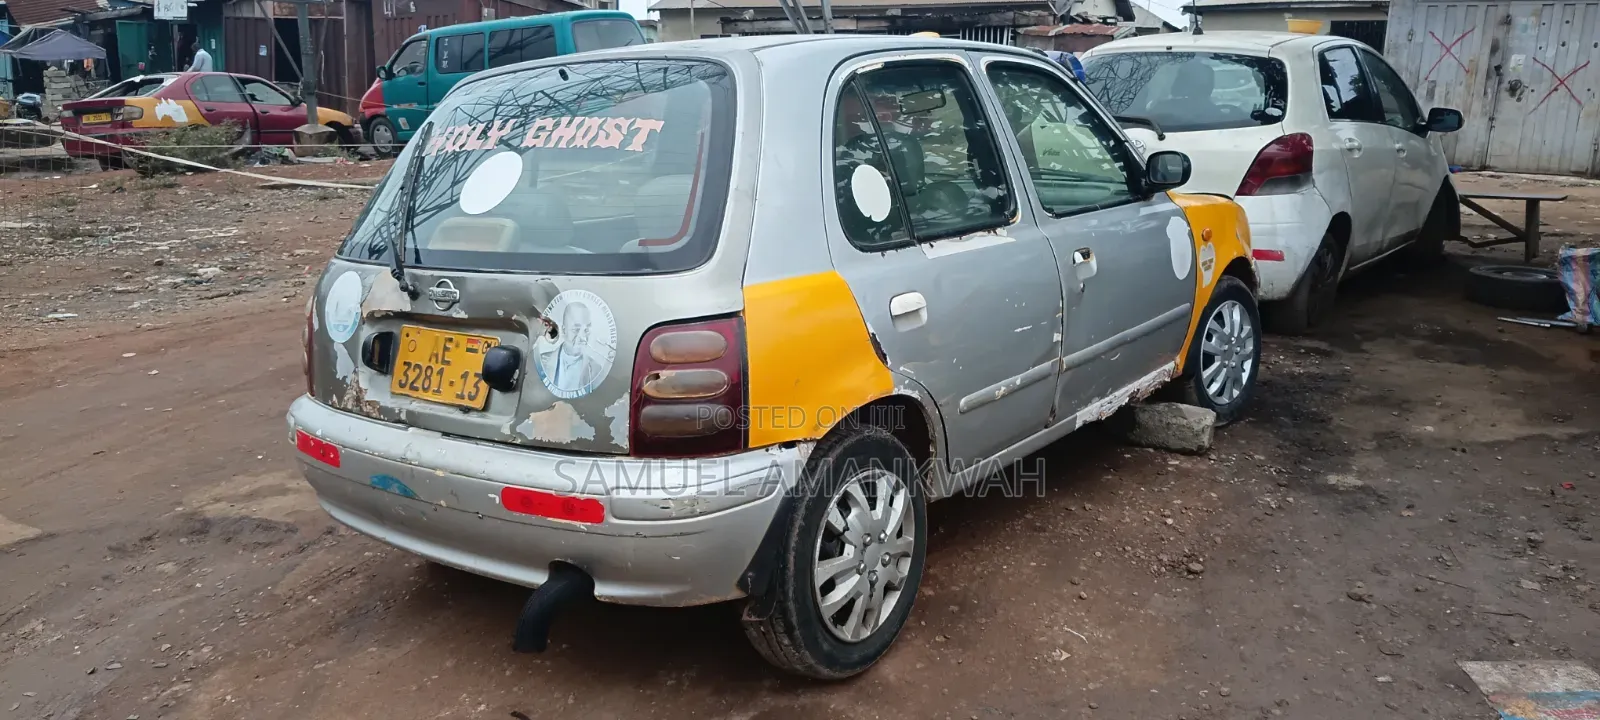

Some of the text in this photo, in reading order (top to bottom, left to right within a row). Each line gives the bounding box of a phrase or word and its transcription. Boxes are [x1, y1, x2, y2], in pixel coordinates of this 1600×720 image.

[424, 116, 665, 157] HOLY GHOST
[428, 336, 454, 366] AE
